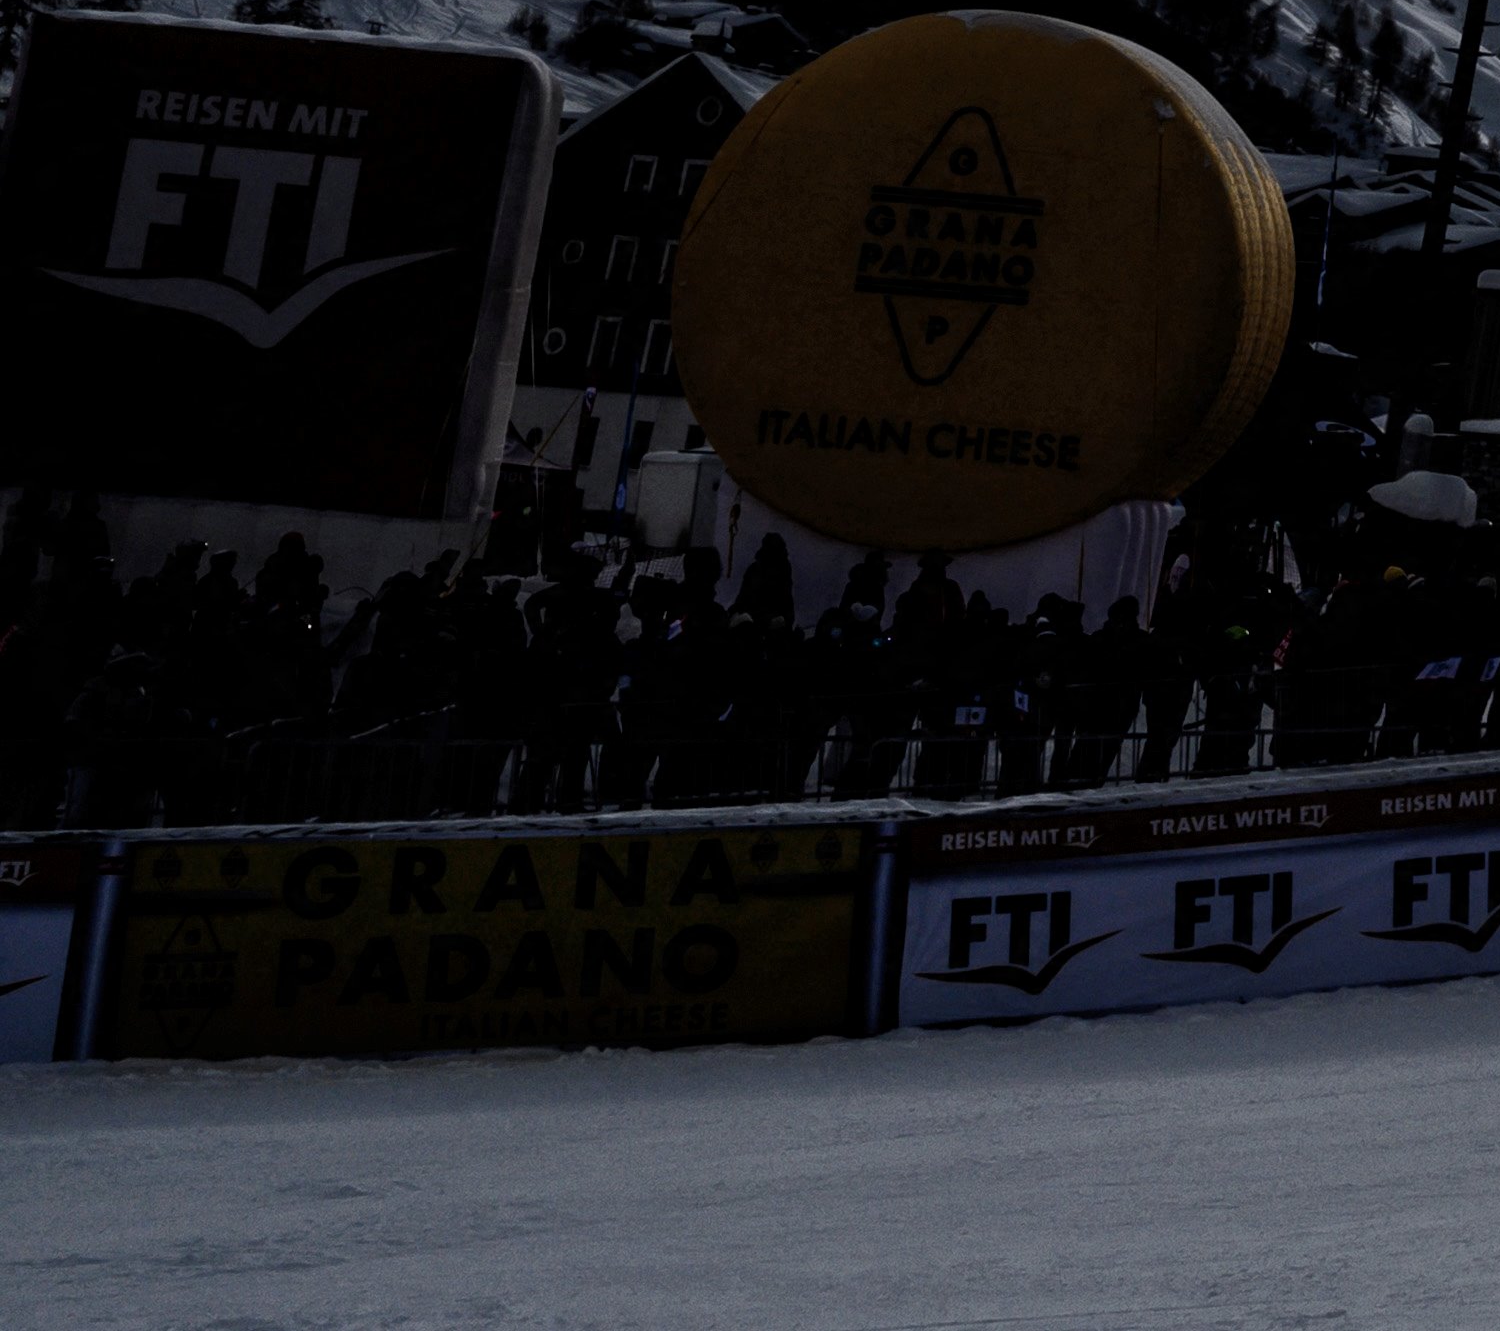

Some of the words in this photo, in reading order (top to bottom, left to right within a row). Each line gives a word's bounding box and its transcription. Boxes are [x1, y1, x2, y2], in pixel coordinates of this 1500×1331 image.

[135, 89, 279, 131] REISEN
[288, 103, 369, 140] MIT
[949, 147, 979, 176] G
[104, 139, 363, 291] FTI
[865, 205, 1038, 249] GRANA
[858, 242, 1035, 286] PADANO
[925, 315, 950, 345] P
[757, 410, 913, 455] ITALIAN
[925, 423, 1082, 472] CHEESE
[1150, 813, 1229, 836] TRAVEL
[1234, 804, 1292, 831] WITH
[1299, 804, 1328, 826] FTI
[1380, 793, 1452, 816] REISEN
[1458, 788, 1497, 809] MIT
[940, 829, 1014, 851] REISEN
[1020, 828, 1060, 847] MIT
[1066, 825, 1096, 845] FTI
[282, 838, 741, 920] GRANA
[948, 891, 1071, 969] FTI
[1174, 872, 1292, 949] FTI
[274, 923, 740, 1008] PADANO
[420, 1010, 569, 1039] ITALIAN
[588, 1001, 729, 1036] CHEESE
